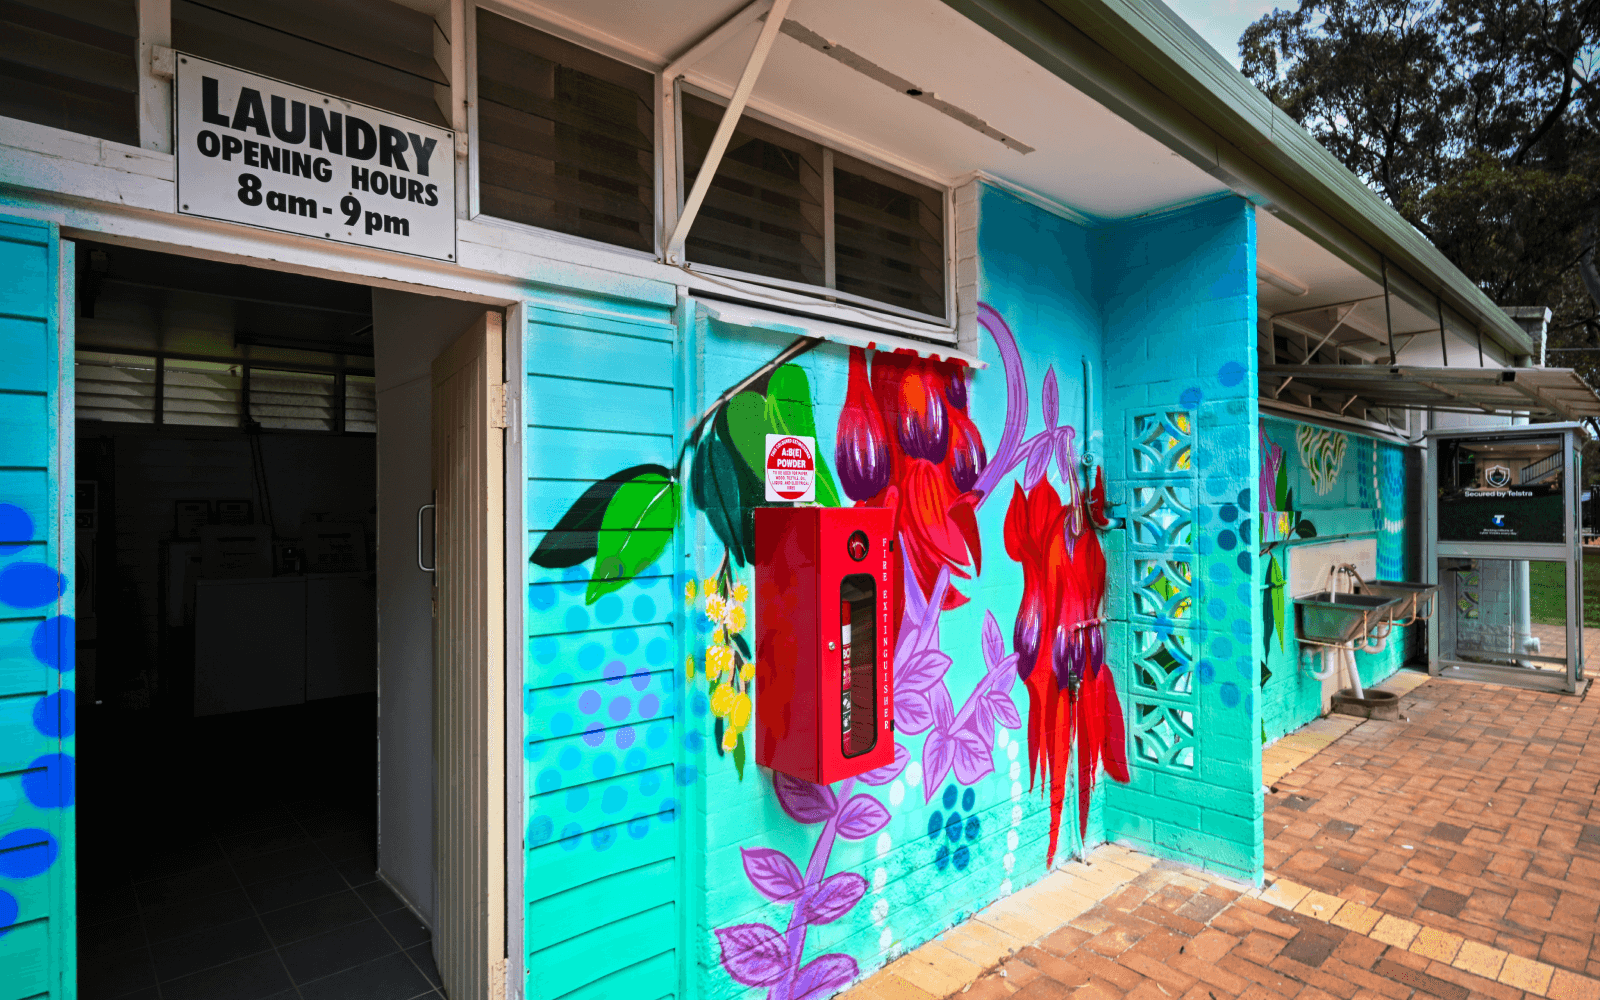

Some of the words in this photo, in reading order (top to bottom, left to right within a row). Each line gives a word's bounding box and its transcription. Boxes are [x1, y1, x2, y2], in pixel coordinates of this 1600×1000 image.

[201, 75, 438, 177] LAUNDRY
[196, 130, 333, 183] OPENING
[351, 164, 439, 207] HOURS
[237, 173, 318, 219] 8am
[340, 195, 410, 237] 9pm
[777, 459, 806, 468] POWDER
[1496, 490, 1506, 498] by
